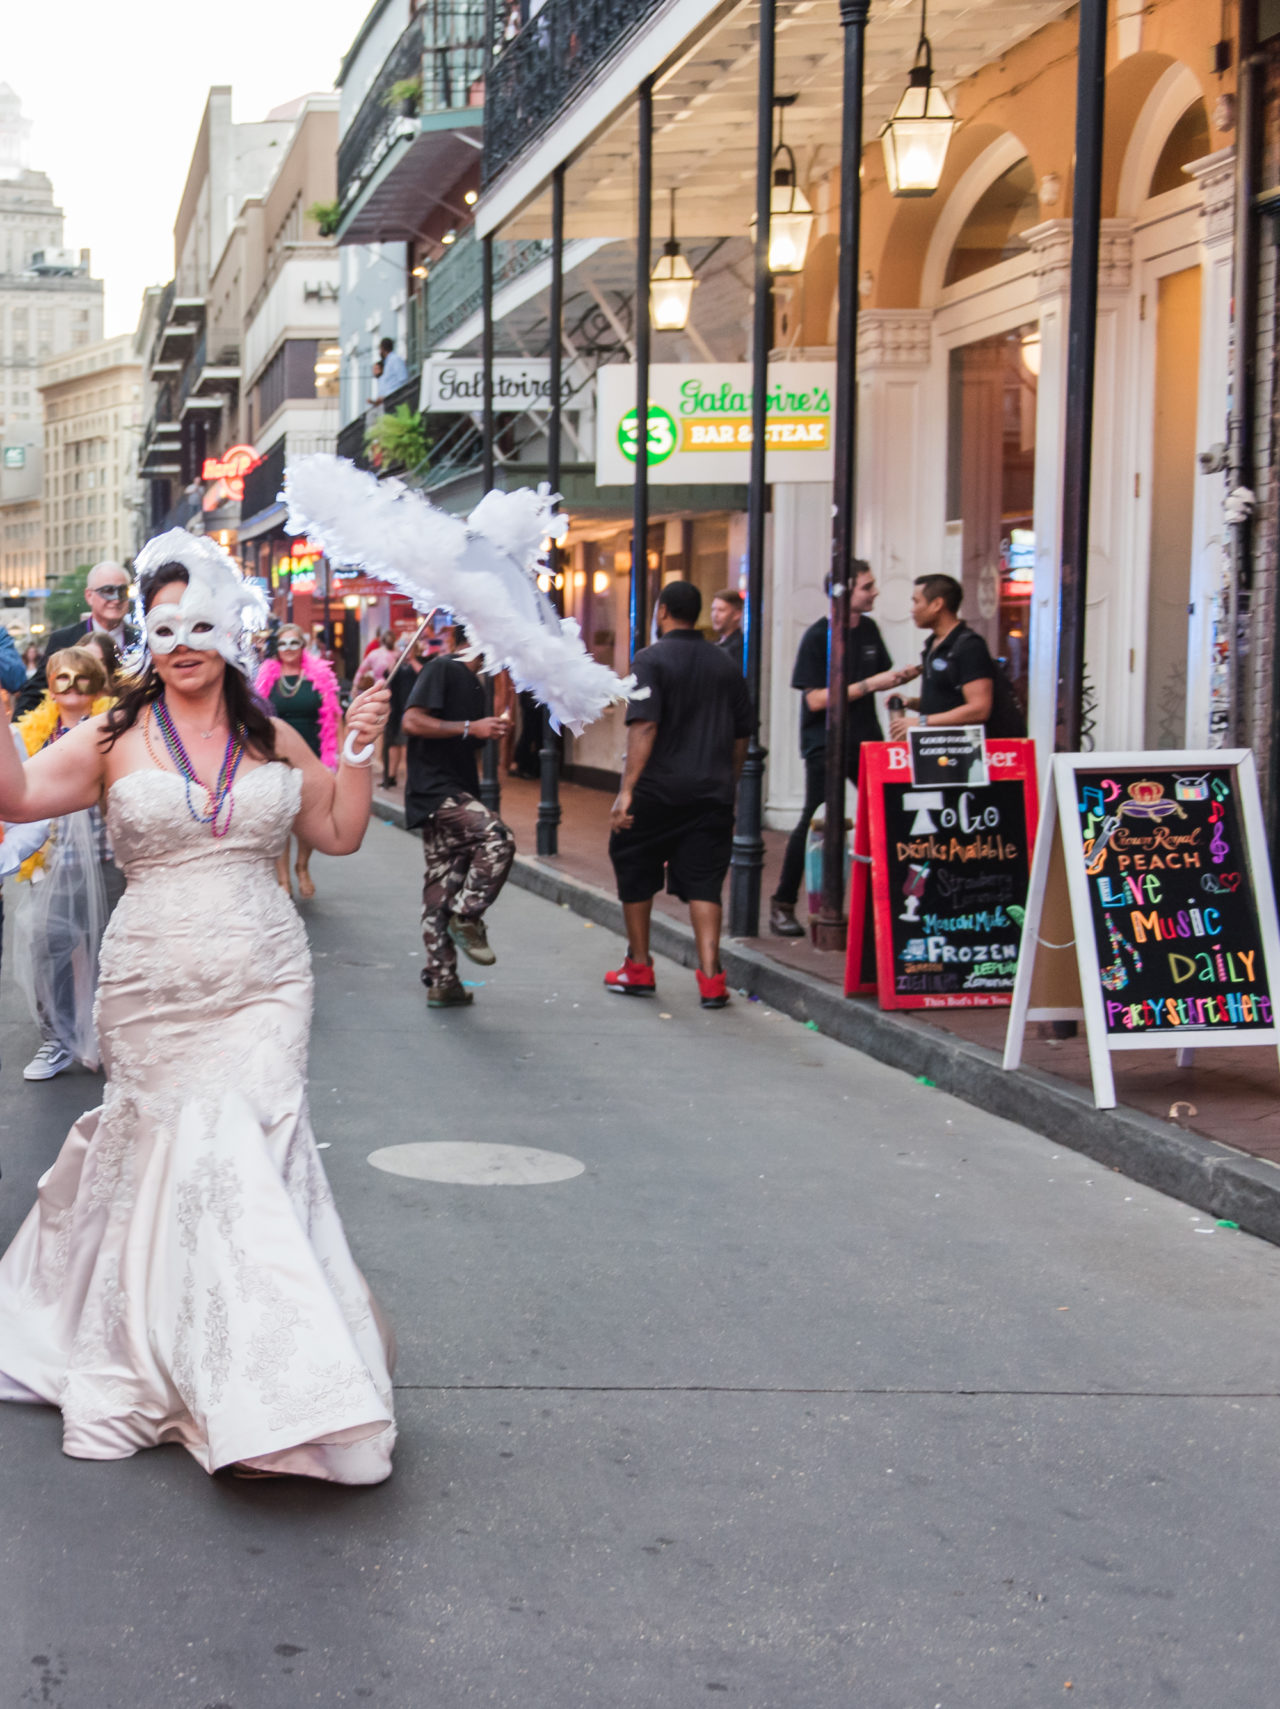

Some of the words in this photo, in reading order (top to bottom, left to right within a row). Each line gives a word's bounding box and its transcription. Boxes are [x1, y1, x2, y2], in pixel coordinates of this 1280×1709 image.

[691, 425, 734, 443] BAR
[765, 423, 825, 442] TEAK
[903, 791, 957, 836] To
[958, 791, 1000, 834] Go
[1109, 827, 1151, 851] Crown
[1151, 826, 1202, 850] Royal
[1118, 852, 1201, 871] PEACH
